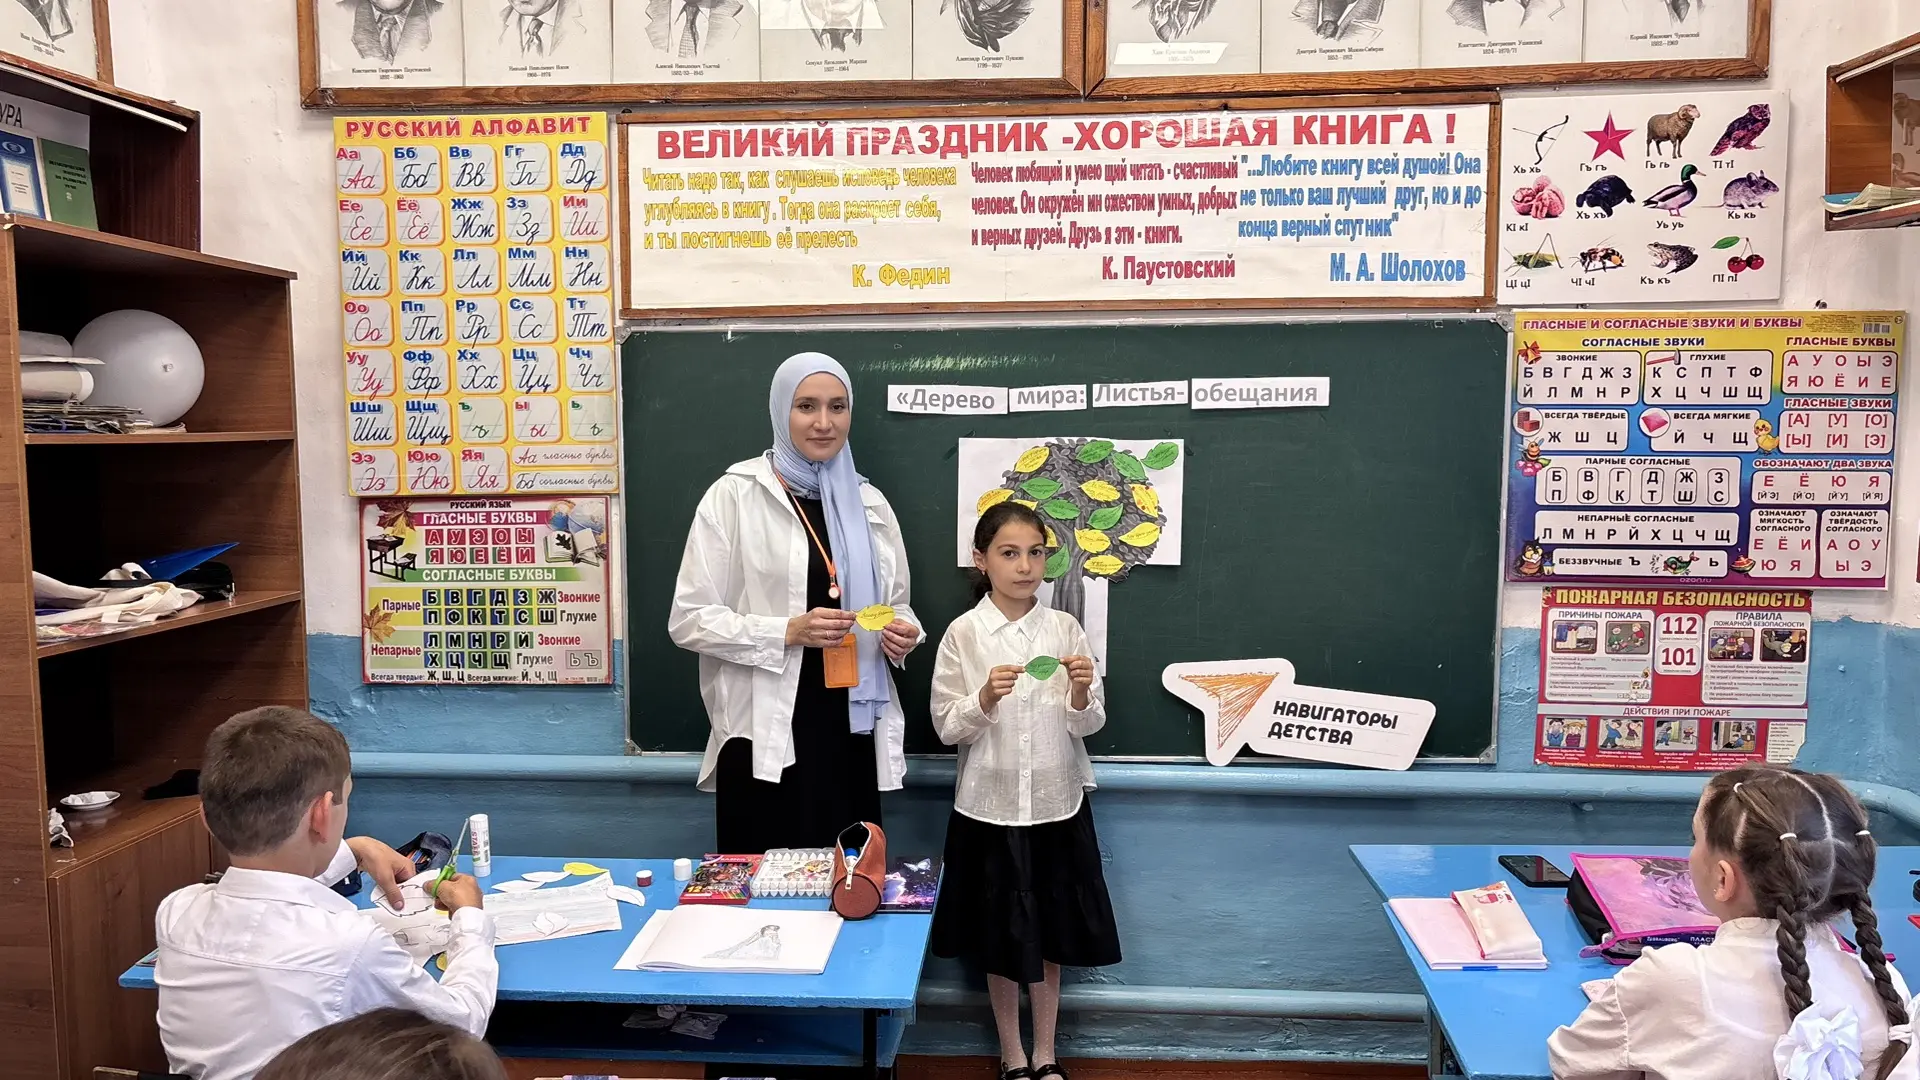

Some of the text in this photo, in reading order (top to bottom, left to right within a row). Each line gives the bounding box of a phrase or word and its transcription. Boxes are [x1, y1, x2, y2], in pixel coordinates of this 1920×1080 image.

[346, 115, 592, 139] РУССКИЙ АЛФАВИТ
[657, 121, 834, 159] ВЕЛИКИЙ
[846, 122, 1048, 159] ПРАЗДНИК
[1293, 114, 1433, 146] КНИГА
[971, 161, 1013, 184] Человек
[1015, 160, 1062, 185] любящий
[1065, 165, 1072, 182] и
[1129, 164, 1164, 181] читать
[1173, 155, 1238, 181] счастливый
[1321, 157, 1364, 180] книгу
[1367, 152, 1399, 175] всей
[1402, 152, 1450, 179] душой!
[1454, 152, 1481, 174] Она
[642, 165, 957, 195] Читать надо так, как слушаешь исповедь человека
[971, 196, 1017, 216] человек.
[1020, 190, 1035, 214] Он
[1038, 189, 1084, 219] окружён
[1157, 193, 1195, 217] умных,
[1197, 186, 1237, 215] добрых
[1240, 180, 1482, 211] не только ваш лучший друг, но и до
[644, 197, 719, 226] углубляясь
[722, 201, 729, 219] в
[779, 196, 815, 224] Тогда
[818, 201, 840, 219] она
[843, 199, 901, 224] раскроет
[904, 195, 942, 222] себя,
[1238, 220, 1278, 241] конца
[1281, 213, 1331, 242] верный
[644, 227, 858, 254] и ты постигнешь её прелесть
[971, 228, 978, 246] и
[981, 227, 1021, 251] верных
[1024, 222, 1066, 250] друзей.
[1114, 226, 1135, 244] эти
[1102, 253, 1236, 285] К. Паустовский
[1330, 252, 1466, 281] М. А. Шолохов
[852, 263, 951, 290] К. Федин
[1523, 319, 1586, 329] ГЛАСНЫЕ
[1590, 319, 1600, 329] И
[1604, 318, 1688, 329] СОГЛАСНЫЕ
[1692, 318, 1736, 328] ЗВУКИ
[1740, 318, 1749, 328] И
[1754, 318, 1802, 328] БУКВЫ
[1582, 338, 1705, 347] СОГЛАСНЫЕ ЗВУКИ
[1786, 337, 1896, 347] ГЛАСНЫЕ БУКВЫ
[896, 383, 1318, 410] «Дерево мира: Листья- обещания
[1785, 399, 1892, 408] ГЛАСНЫЕ ЗВУКИ
[1673, 412, 1711, 420] ВСЕГДА
[542, 450, 614, 463] гласные буквы
[1754, 460, 1892, 468] ОБОЗНАЧАЮТ ДВА ЗВУКА
[539, 476, 615, 489] согласные буквы
[450, 500, 512, 509] РУССКИЙ ЯЗЫК
[423, 512, 537, 525] ГЛАСНЫЕ БУКВЫ
[1577, 514, 1631, 522] НЕПАРНЫЕ
[422, 568, 556, 581] СОГЛАСНЫЕ БУКВЫ
[557, 591, 600, 603] Звонкие
[1556, 588, 1806, 608] ПОЖАРНАЯ БЕЗОПАСНОСТЬ
[382, 599, 421, 613] Парные
[560, 611, 597, 624] Глухие
[1559, 611, 1643, 620] ПРИЧИНЫ ПОЖАРА
[1735, 611, 1783, 621] ПРАВИЛА
[1661, 616, 1698, 635] 112
[1754, 620, 1805, 628] БЕЗОПАСНОСТИ
[538, 634, 581, 646] Звонкие
[371, 643, 422, 658] Непарные
[1661, 647, 1697, 666] 101
[516, 653, 553, 667] Глухие
[371, 673, 395, 682] Всегда
[467, 674, 490, 683] Всегда
[1273, 700, 1398, 730] НАВИГАТОРЫ
[1623, 706, 1731, 717] ДЕЙСТВИЯ ПРИ ПОЖАРЕ
[1267, 721, 1353, 745] ДЕТСТВА
